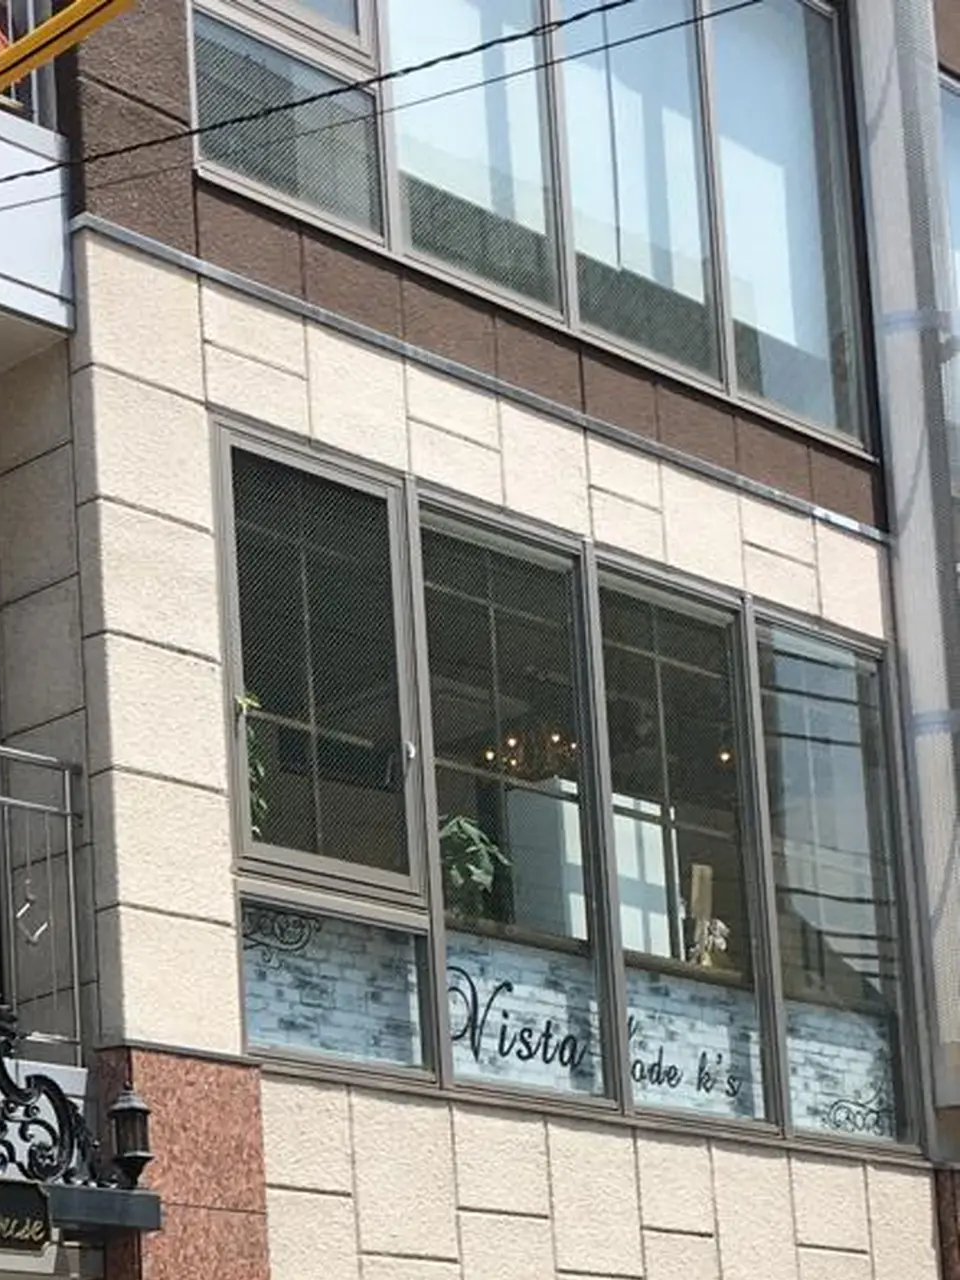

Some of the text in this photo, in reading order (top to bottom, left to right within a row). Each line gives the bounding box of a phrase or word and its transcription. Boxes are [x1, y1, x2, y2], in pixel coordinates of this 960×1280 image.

[446, 966, 588, 1068] Vista
[631, 1045, 683, 1088] ode
[696, 1051, 742, 1097] k's
